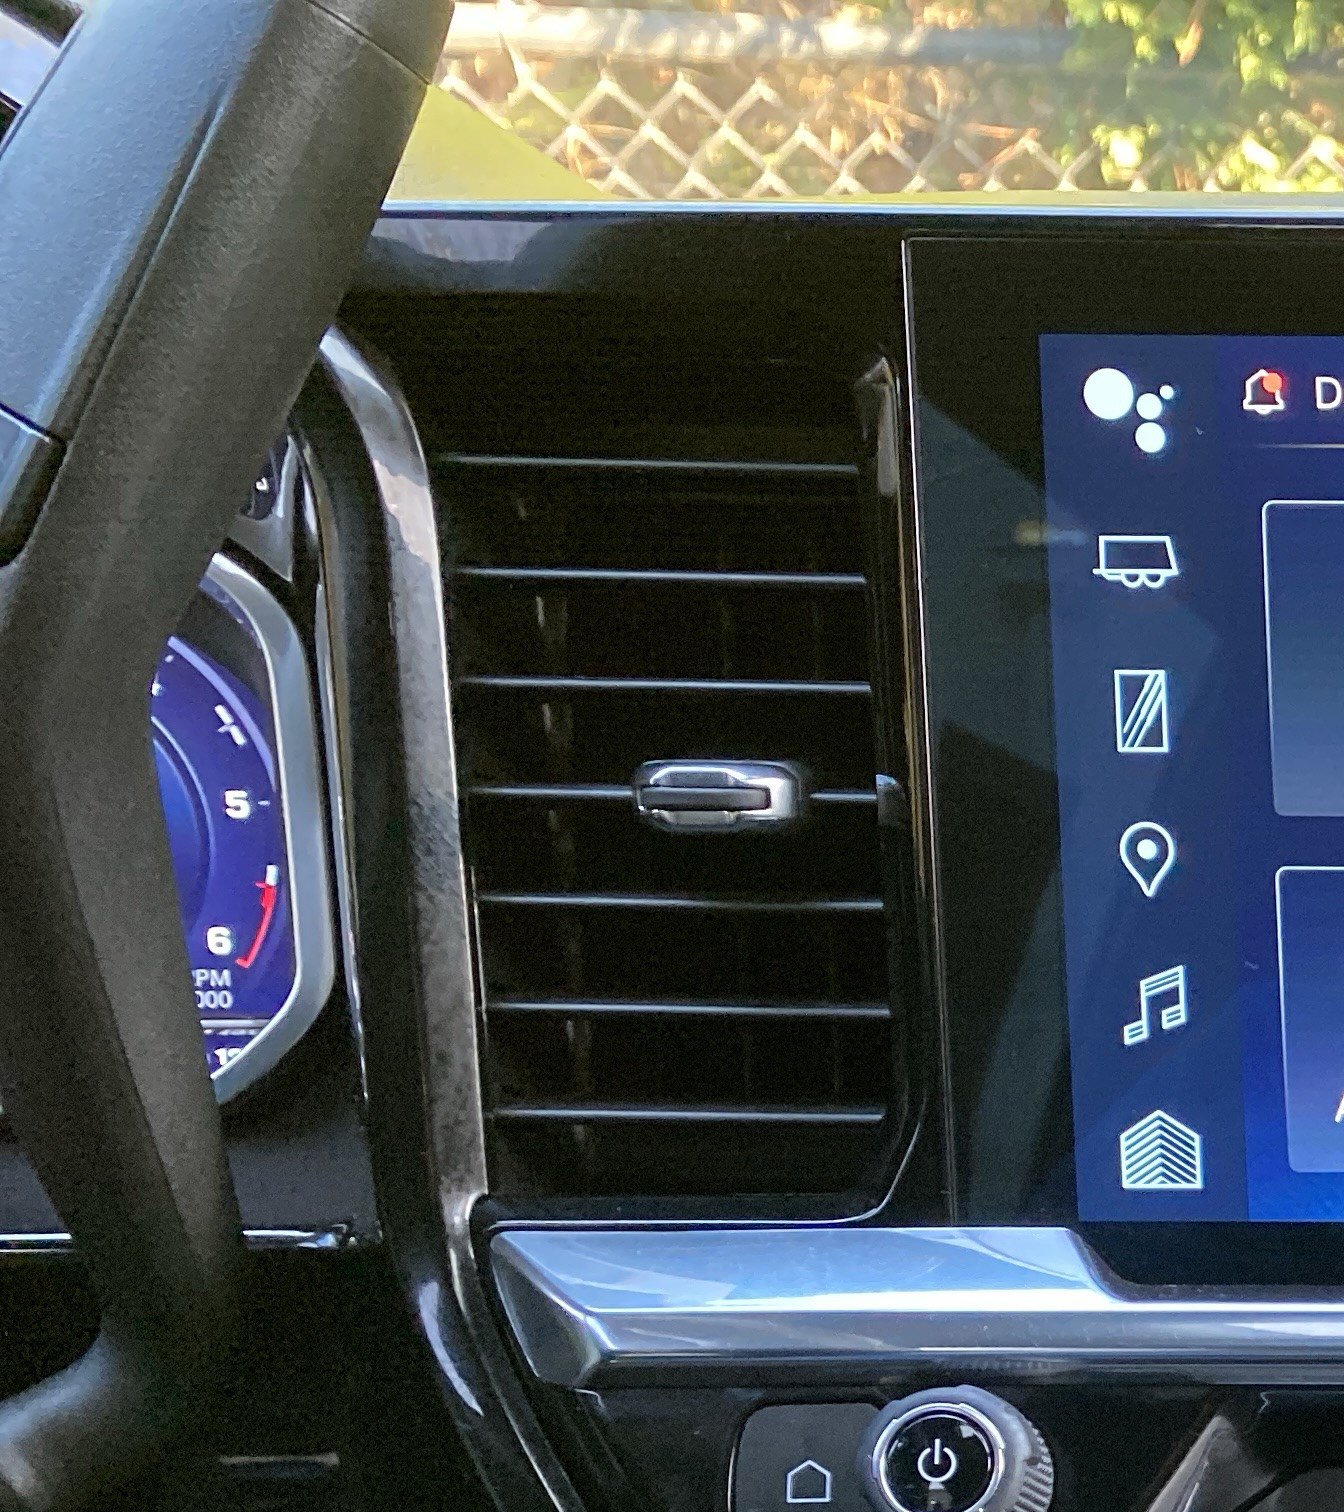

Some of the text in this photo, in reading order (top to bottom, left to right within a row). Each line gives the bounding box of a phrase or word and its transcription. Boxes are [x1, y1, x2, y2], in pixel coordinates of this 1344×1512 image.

[224, 790, 251, 819] 5
[206, 926, 233, 956] 6
[191, 968, 233, 987] PM
